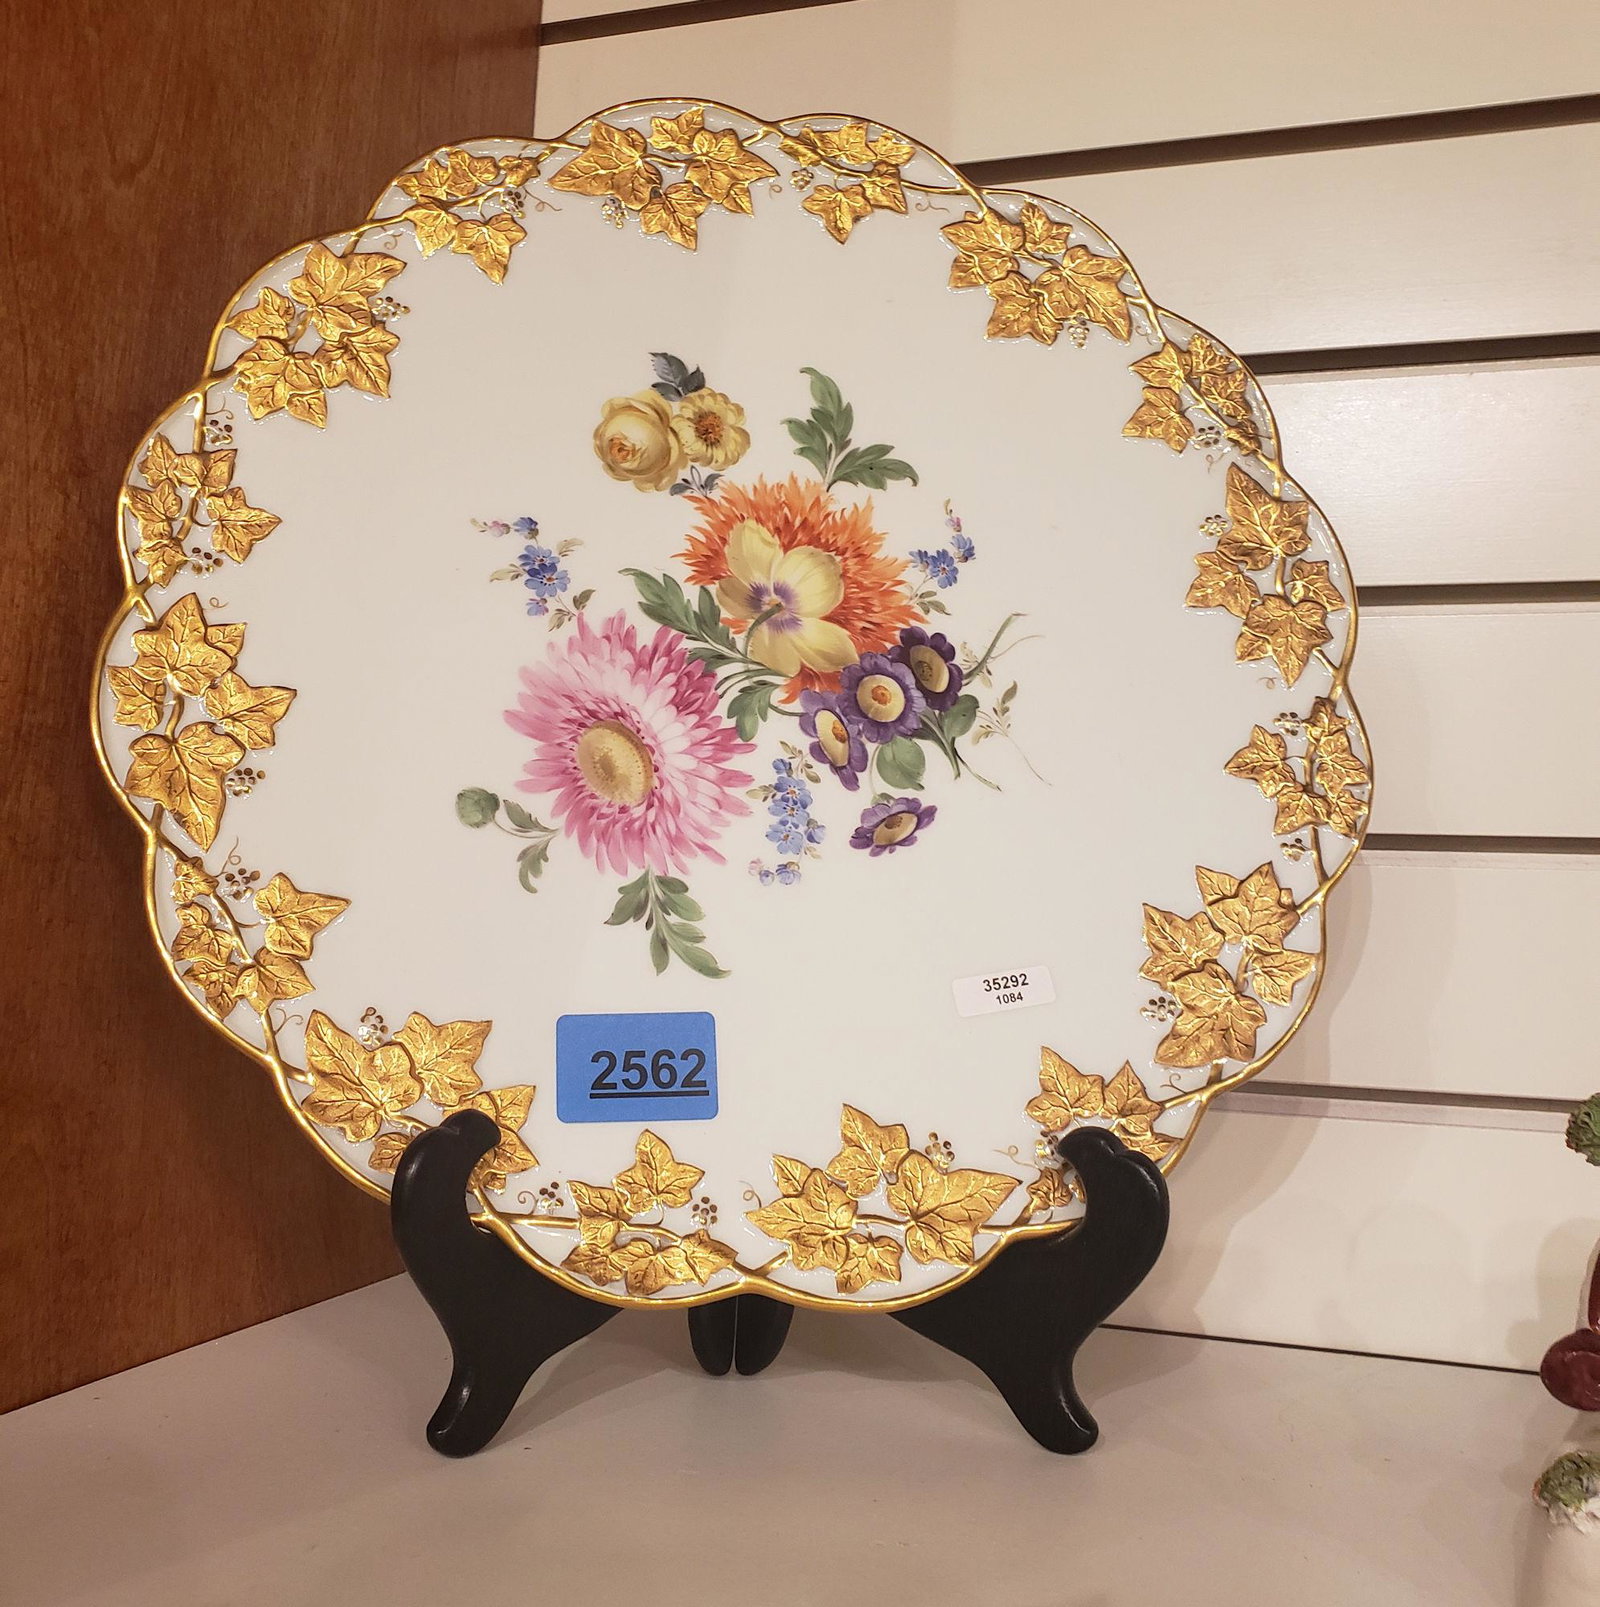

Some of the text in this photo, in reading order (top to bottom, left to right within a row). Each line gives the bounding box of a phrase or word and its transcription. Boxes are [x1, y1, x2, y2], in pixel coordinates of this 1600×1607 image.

[983, 973, 1029, 992] 35292
[995, 991, 1024, 1005] 1084
[590, 1048, 707, 1091] 2562
